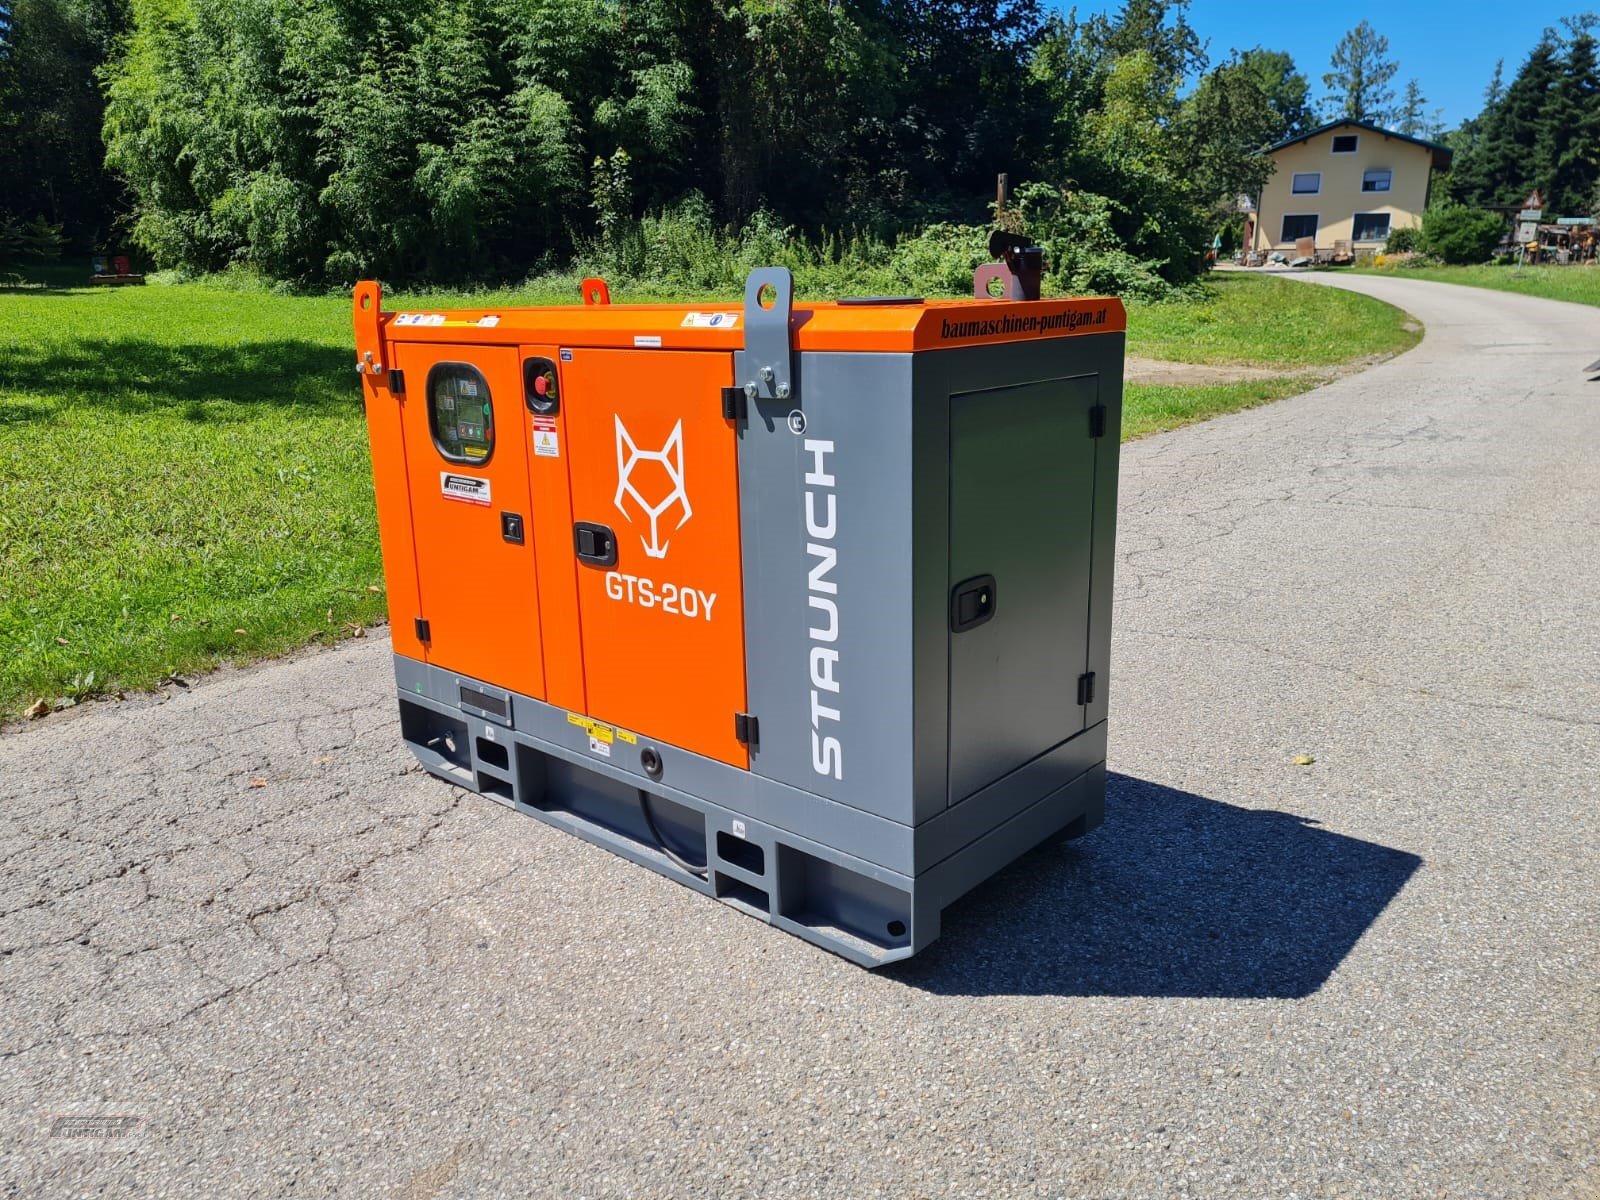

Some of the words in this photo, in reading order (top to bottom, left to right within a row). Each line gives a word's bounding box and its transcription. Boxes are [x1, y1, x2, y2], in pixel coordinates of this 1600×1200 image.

[941, 308, 1107, 339] baumaschinen-puntigam.at
[605, 571, 717, 621] GTS-20Y
[804, 438, 843, 780] STAUNCH
